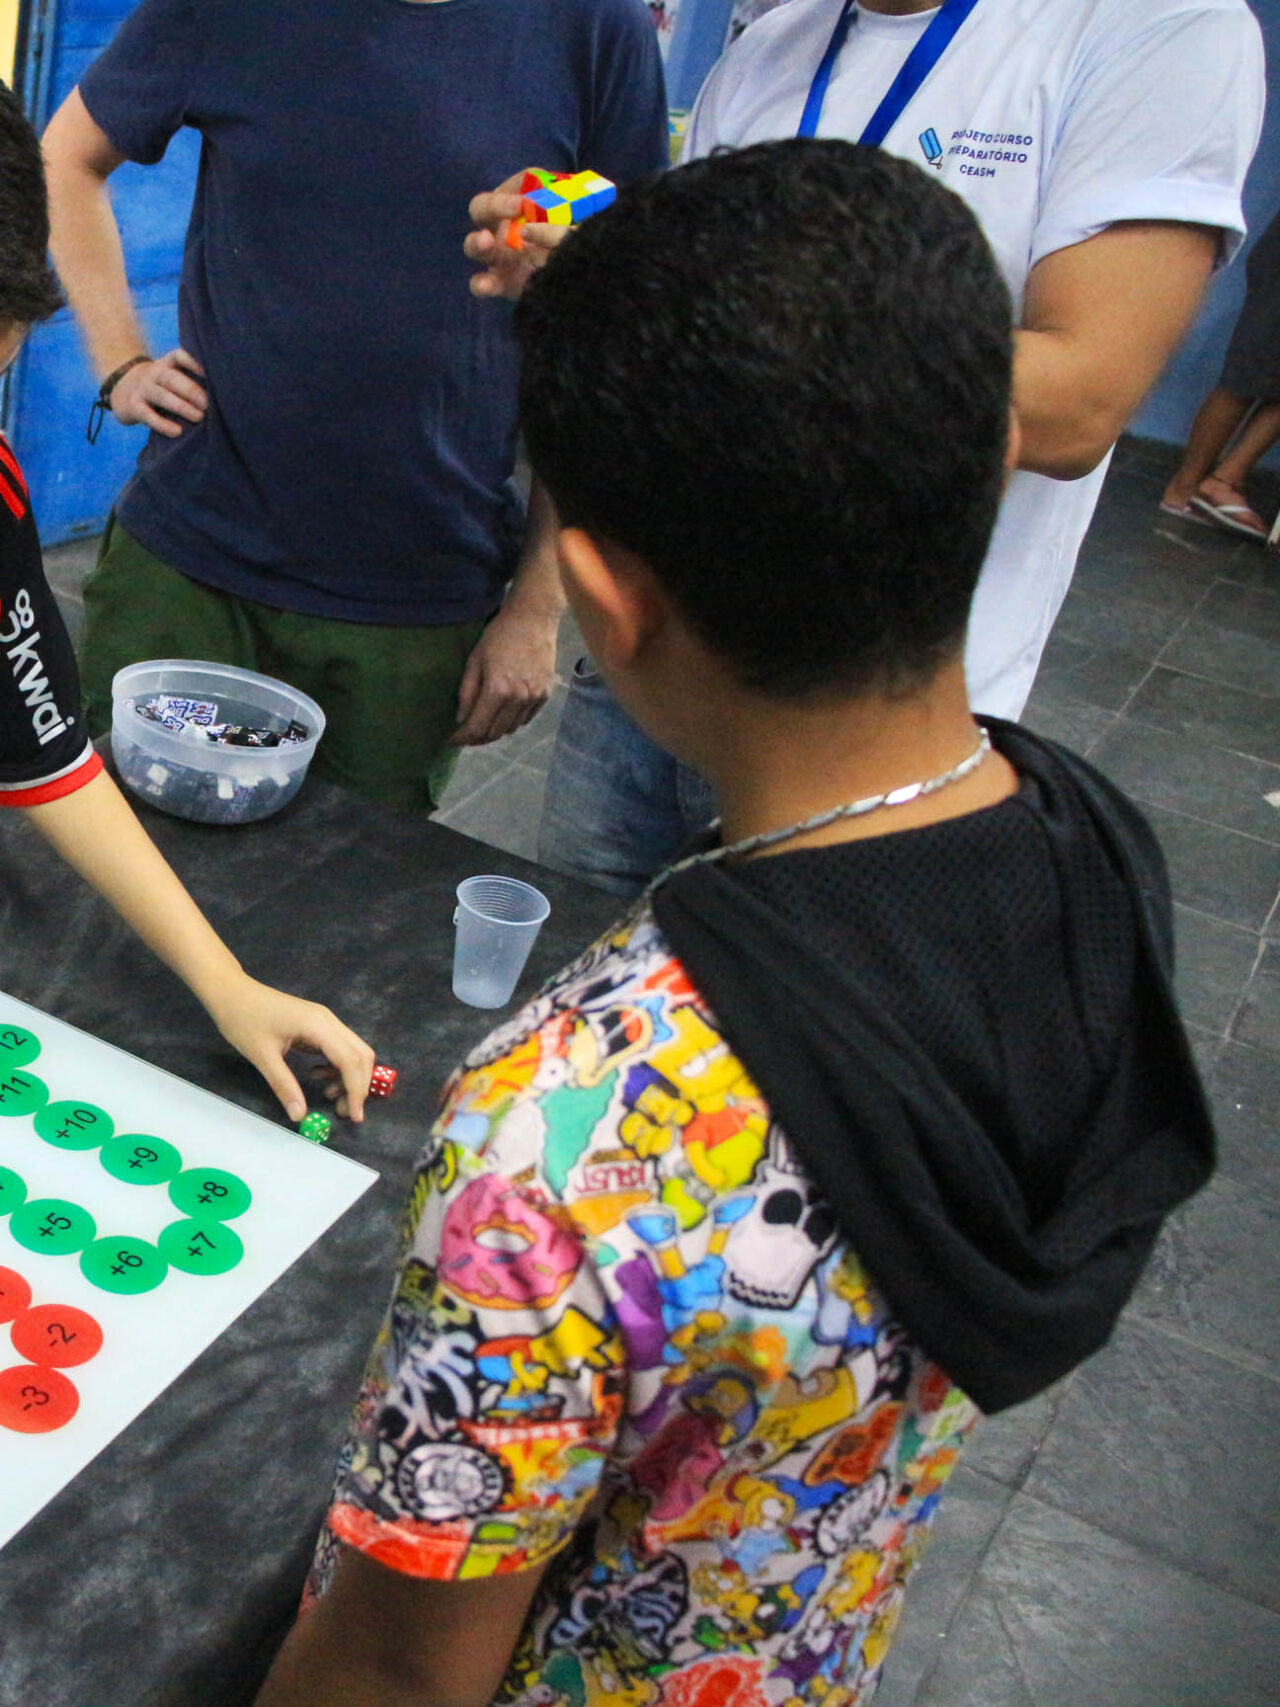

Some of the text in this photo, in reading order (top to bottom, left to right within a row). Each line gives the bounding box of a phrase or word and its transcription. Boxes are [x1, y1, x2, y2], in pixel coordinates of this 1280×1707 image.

[959, 163, 996, 178] CEASM
[6, 631, 75, 746] kwai
[55, 1109, 98, 1138] +10
[128, 1147, 159, 1169] +9
[197, 1181, 229, 1204] +8
[39, 1212, 72, 1237] +5
[187, 1231, 216, 1257] +7
[110, 1250, 143, 1275] +6
[46, 1323, 77, 1346] -2
[20, 1385, 50, 1411] -3
